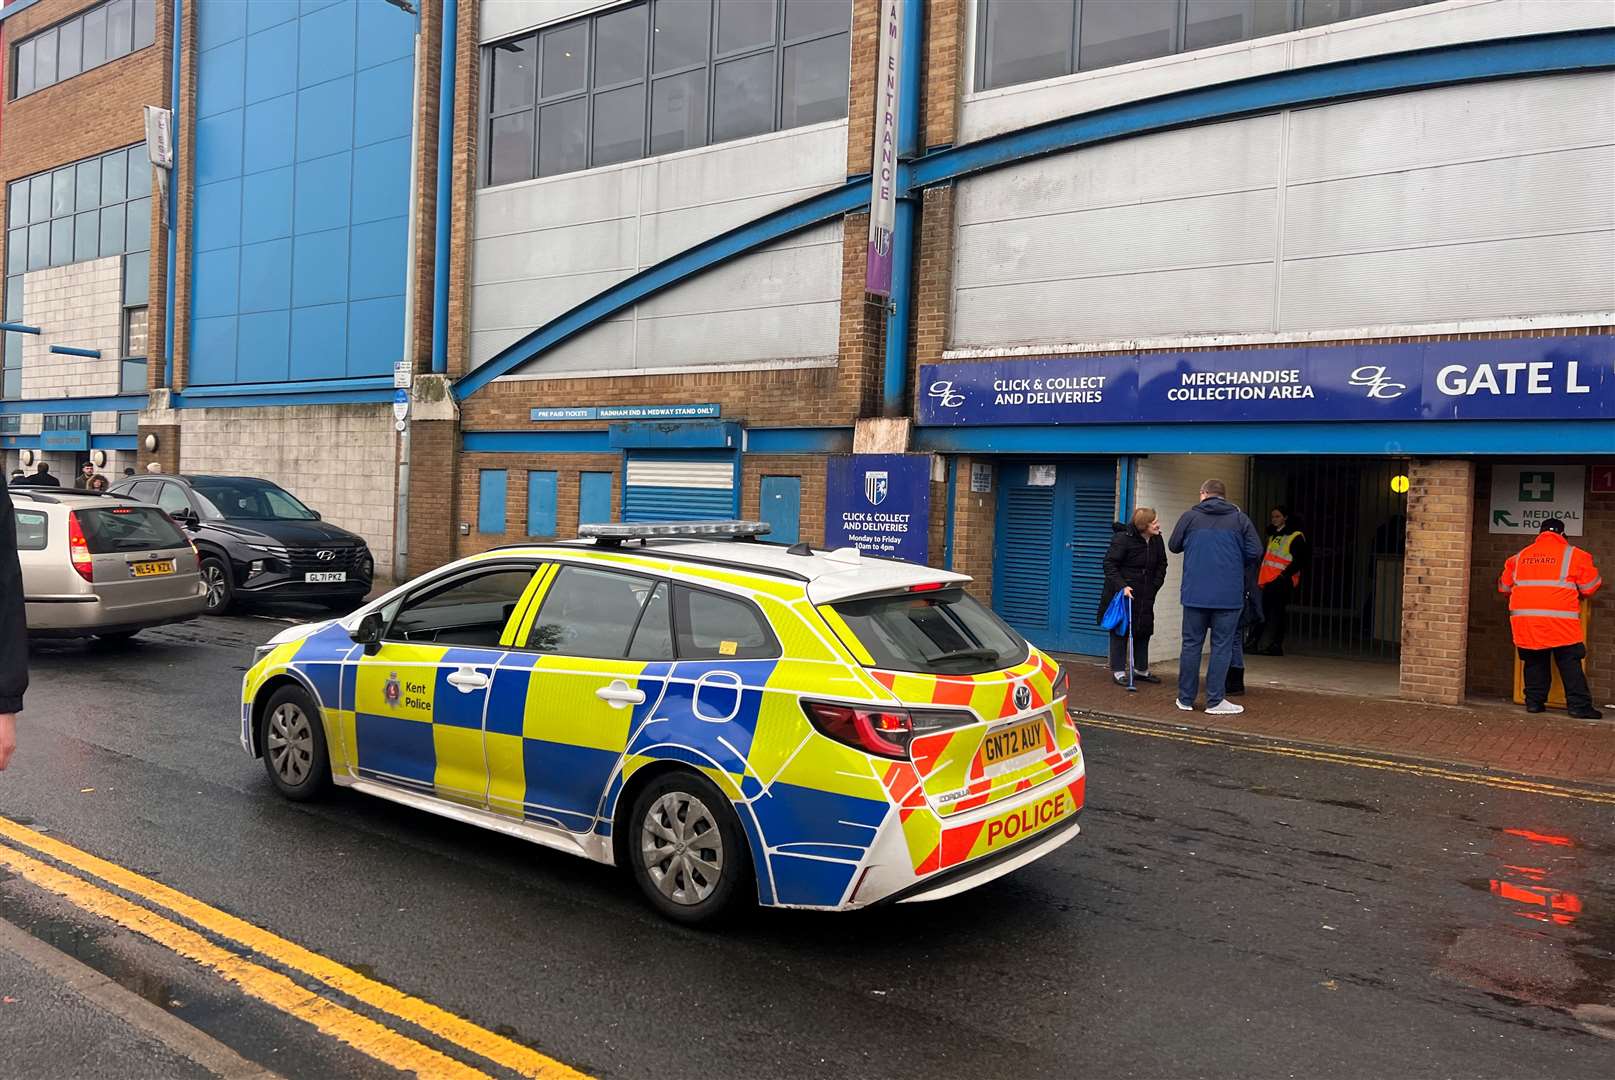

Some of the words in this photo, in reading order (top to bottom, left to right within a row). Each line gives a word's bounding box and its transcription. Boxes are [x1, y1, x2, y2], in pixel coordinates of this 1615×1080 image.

[881, 56, 895, 200] ENTRANCE
[993, 379, 1031, 391] CLICK
[1033, 378, 1043, 390] &
[1046, 376, 1106, 390] COLLECT
[1181, 370, 1300, 385] MERCHANDISE
[1436, 362, 1553, 396] GATE
[1566, 361, 1590, 393] L
[994, 393, 1024, 405] AND
[1026, 390, 1102, 404] DELIVERIES
[1167, 386, 1267, 401] COLLECTION
[1269, 385, 1315, 399] AREA
[648, 408, 674, 416] MEDWAY
[697, 407, 714, 415] ONLY
[842, 513, 865, 521] CLICK
[866, 513, 873, 521] &
[874, 513, 910, 523] COLLECT
[1523, 510, 1580, 519] MEDICAL
[843, 522, 861, 531] AND
[862, 523, 908, 532] DELIVERIES
[848, 534, 873, 543] Monday
[882, 536, 901, 545] Friday
[854, 542, 872, 550] 10am
[880, 544, 895, 552] 4pm
[1521, 557, 1556, 565] STEWARD
[406, 681, 426, 695] Kent
[405, 697, 431, 711] Police
[985, 731, 1019, 761] GN72
[1021, 722, 1042, 750] AUY
[939, 788, 970, 803] COROLLA
[987, 793, 1065, 847] POLICE
